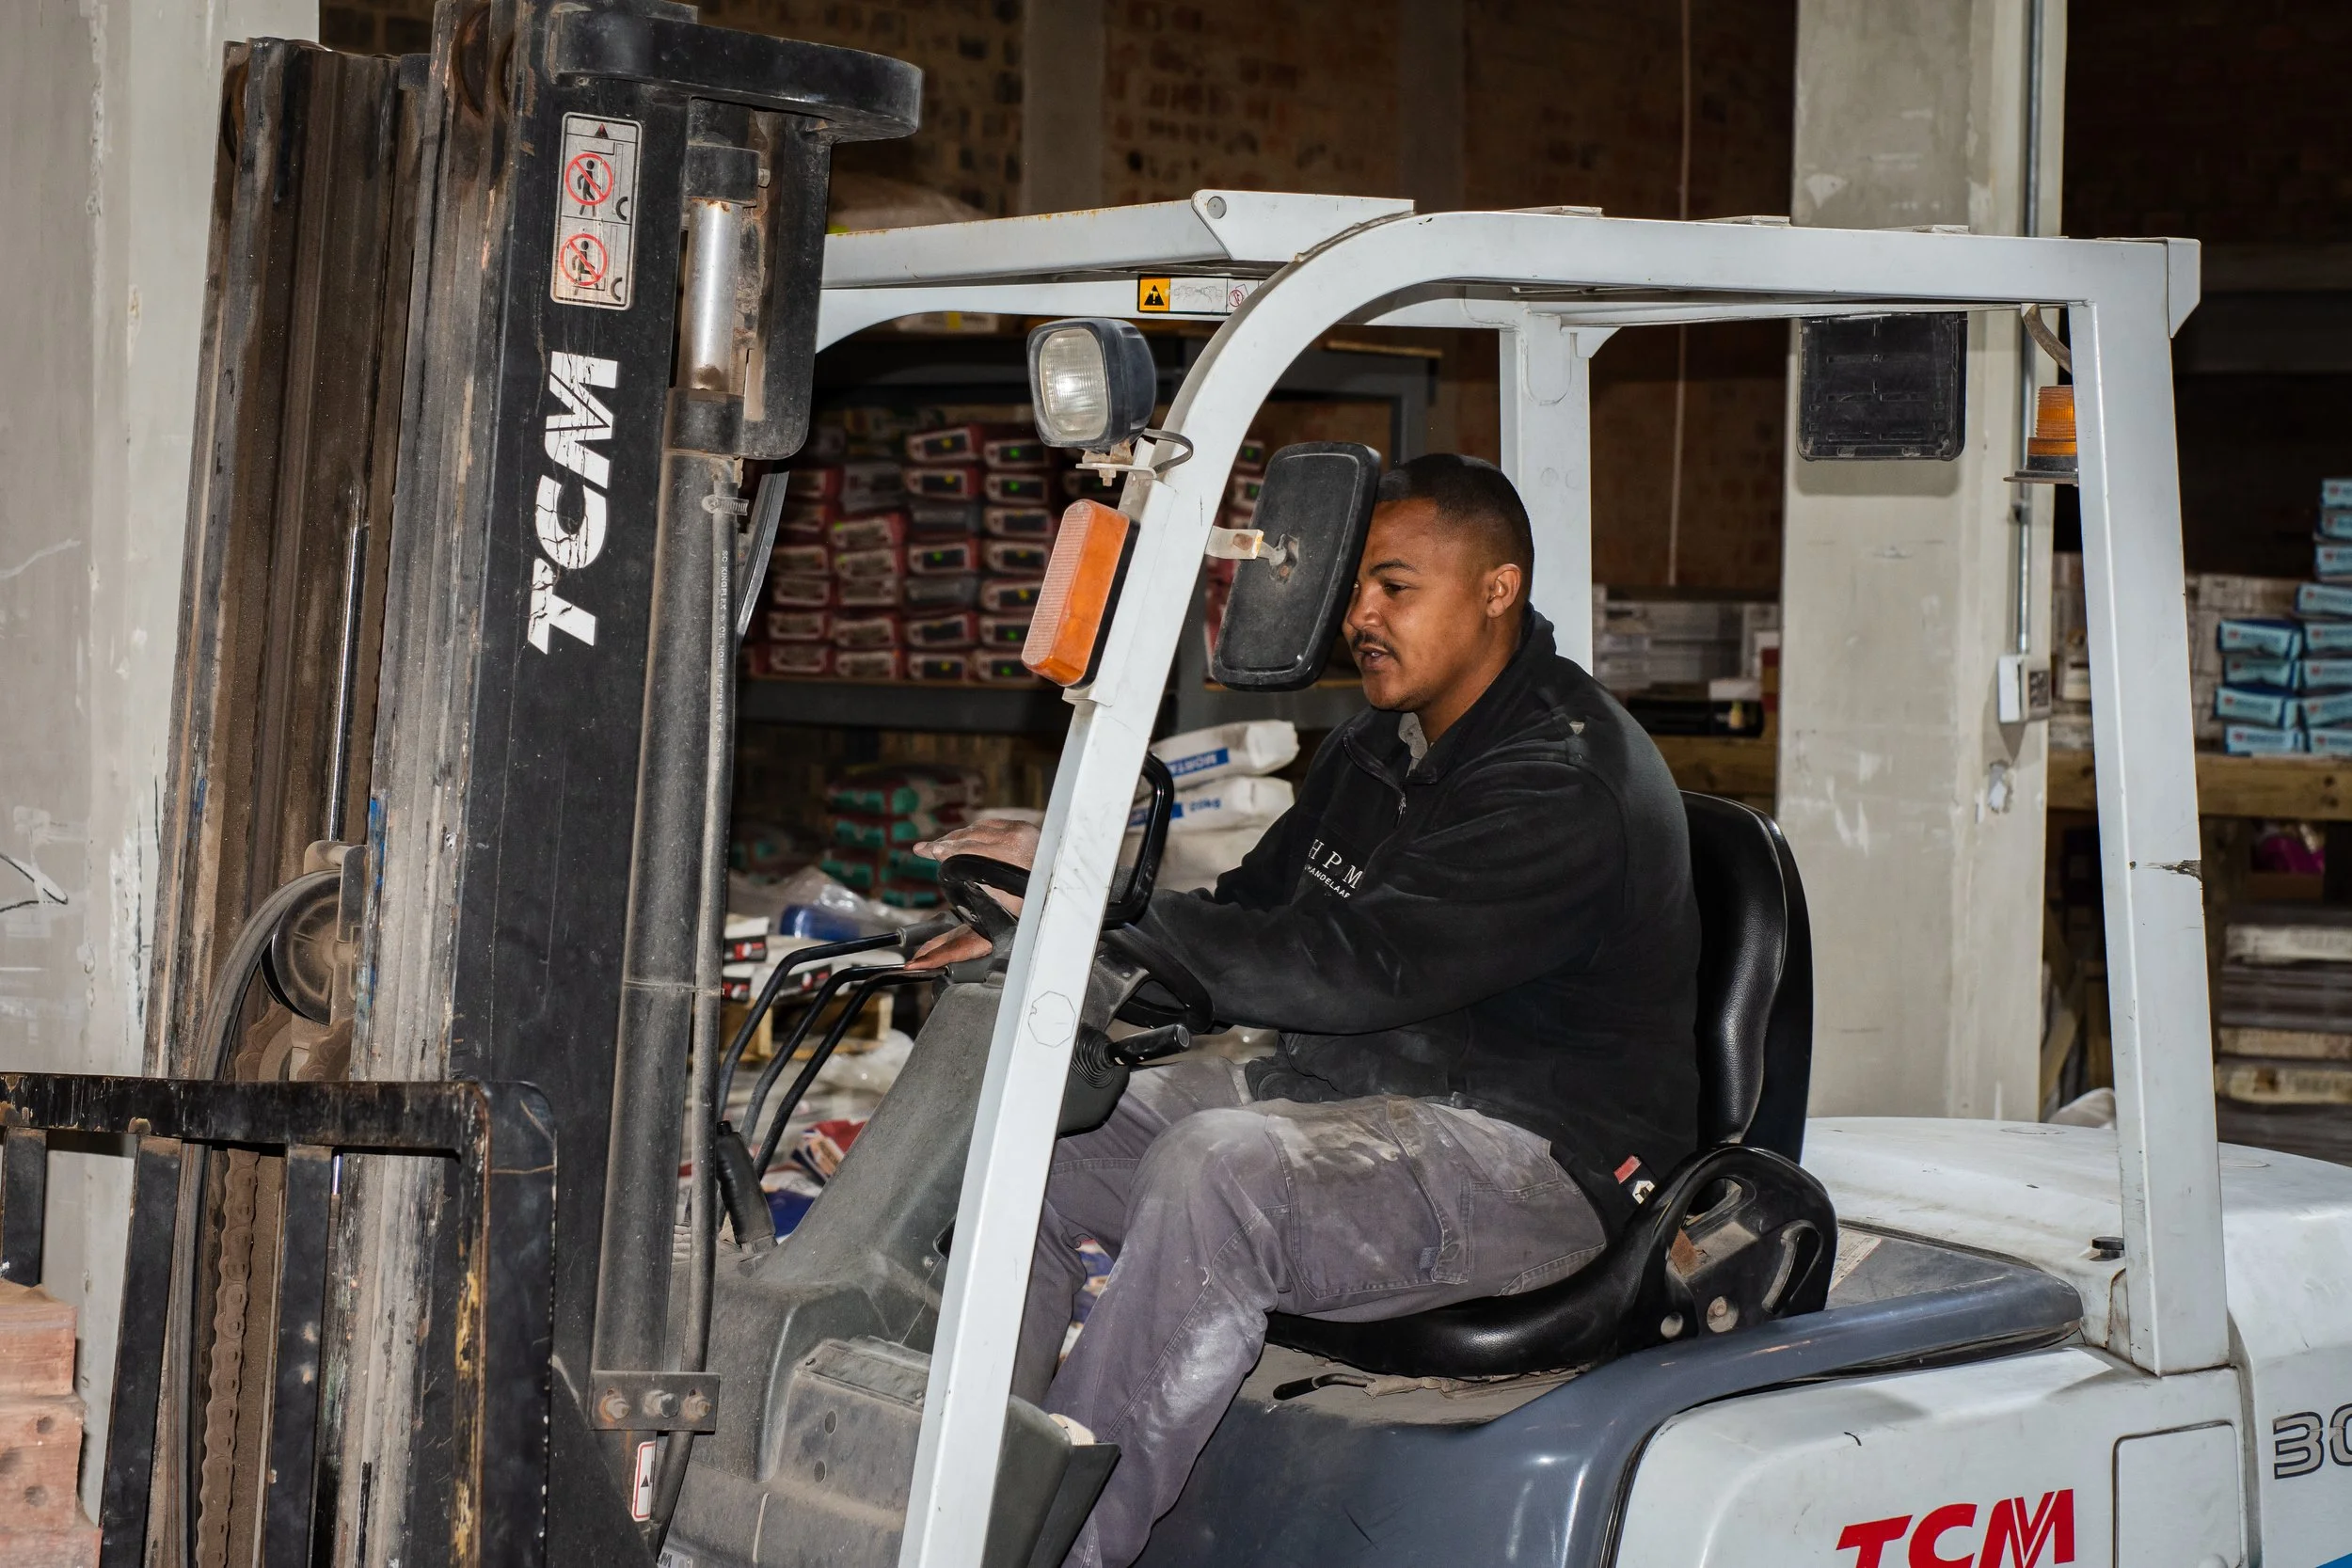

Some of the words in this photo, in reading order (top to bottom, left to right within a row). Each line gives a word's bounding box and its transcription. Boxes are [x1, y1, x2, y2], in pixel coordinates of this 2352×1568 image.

[527, 351, 619, 656] TCM
[716, 644, 726, 669] HOSE
[1836, 1488, 2074, 1568] TCM
